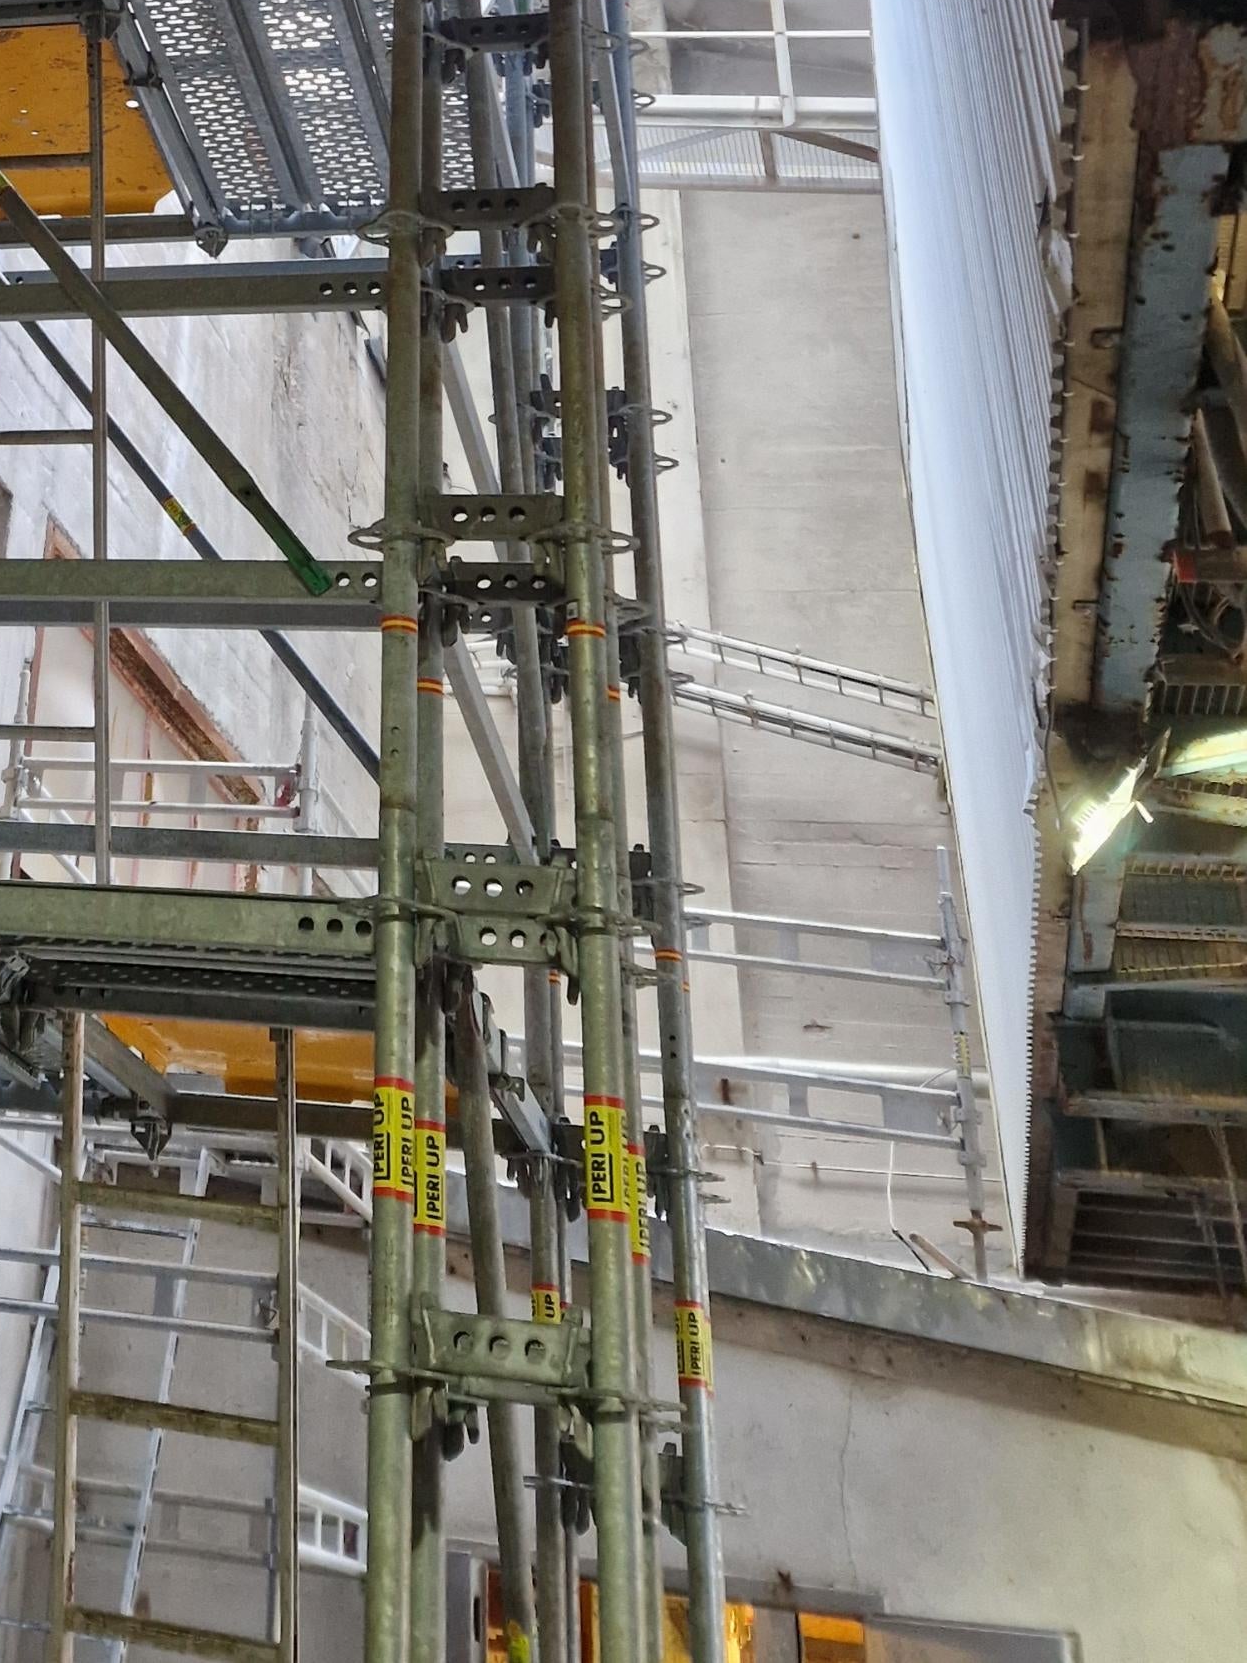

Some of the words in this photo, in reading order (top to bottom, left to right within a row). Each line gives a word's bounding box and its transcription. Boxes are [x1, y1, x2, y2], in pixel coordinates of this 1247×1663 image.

[373, 1092, 385, 1126] UP
[401, 1096, 414, 1131] UP
[589, 1111, 605, 1146] UP
[373, 1132, 384, 1173] PERI
[401, 1137, 413, 1180] PERI
[426, 1135, 440, 1168] UP
[591, 1153, 607, 1195] PERI
[426, 1174, 440, 1214] PERI
[545, 1293, 555, 1319] UP
[688, 1312, 700, 1337] UP
[690, 1341, 702, 1370] PERI
